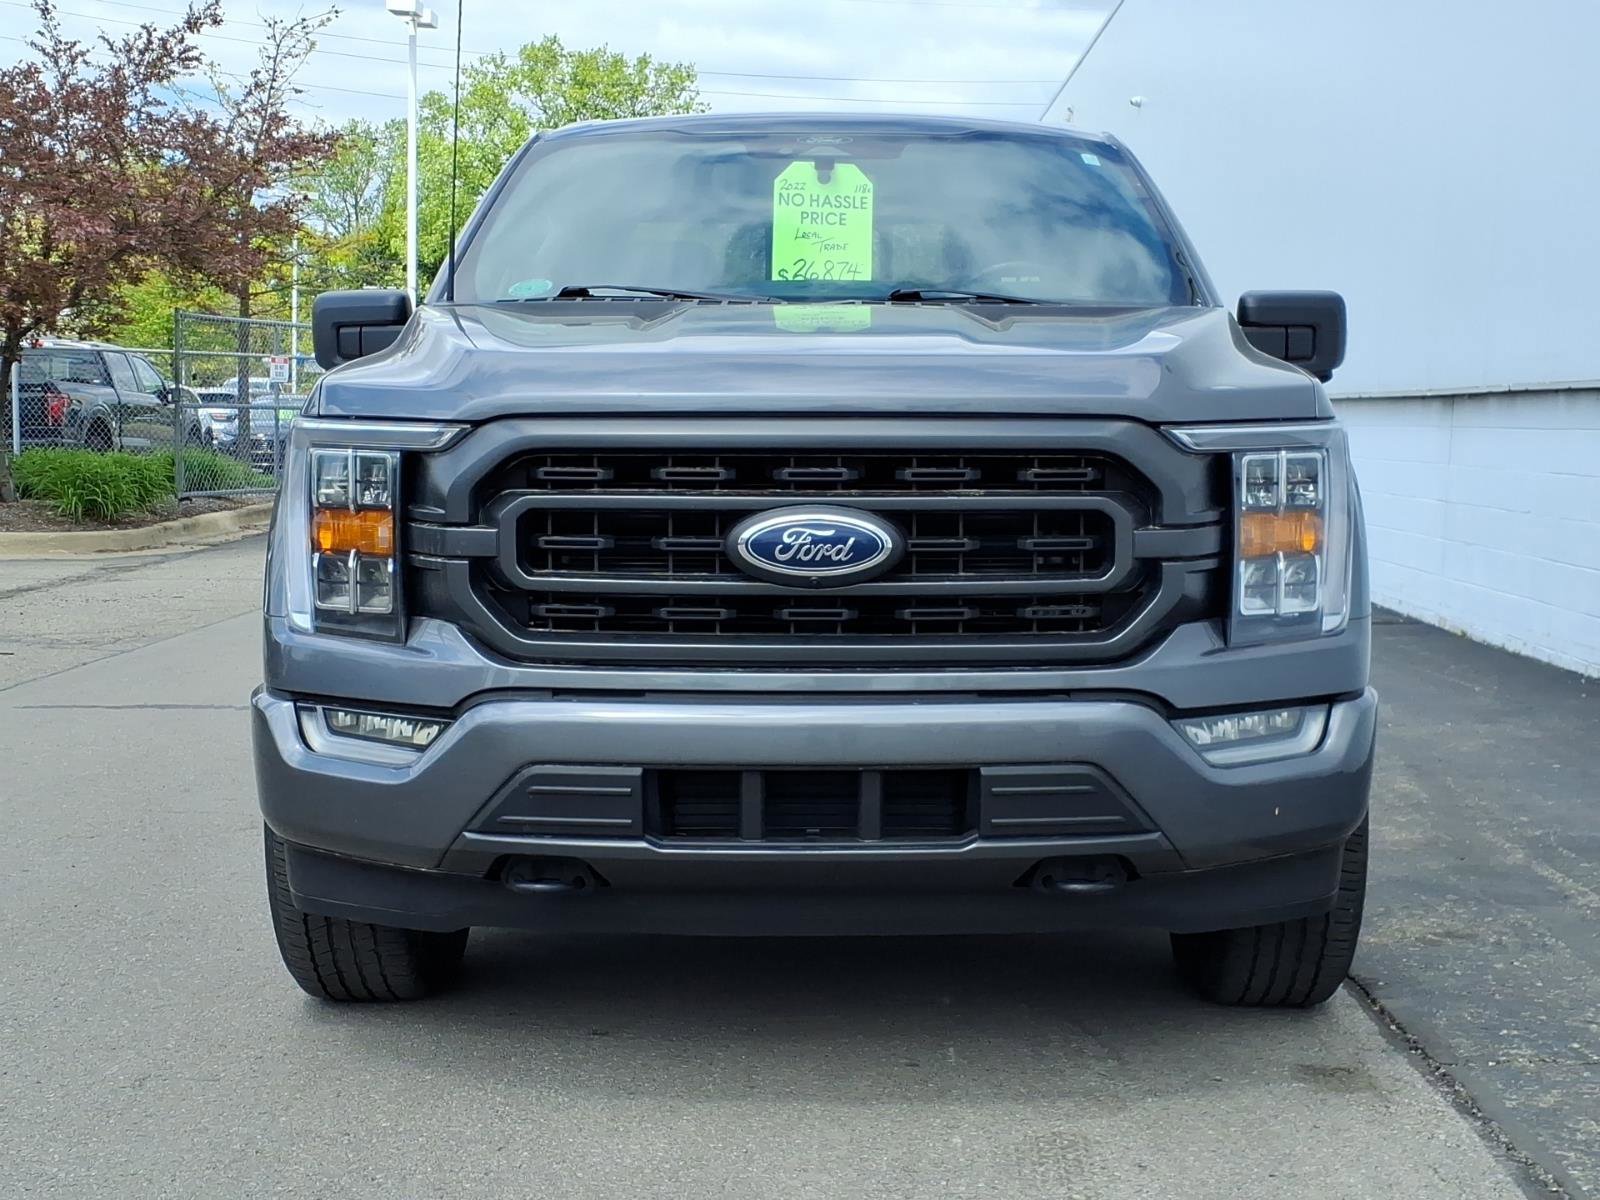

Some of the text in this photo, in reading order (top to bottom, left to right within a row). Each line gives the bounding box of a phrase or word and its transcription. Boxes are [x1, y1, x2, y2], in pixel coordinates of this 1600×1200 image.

[780, 178, 807, 191] 2022
[778, 192, 869, 210] NO HASSLE
[800, 211, 847, 226] PRICE
[774, 527, 855, 562] Ford
